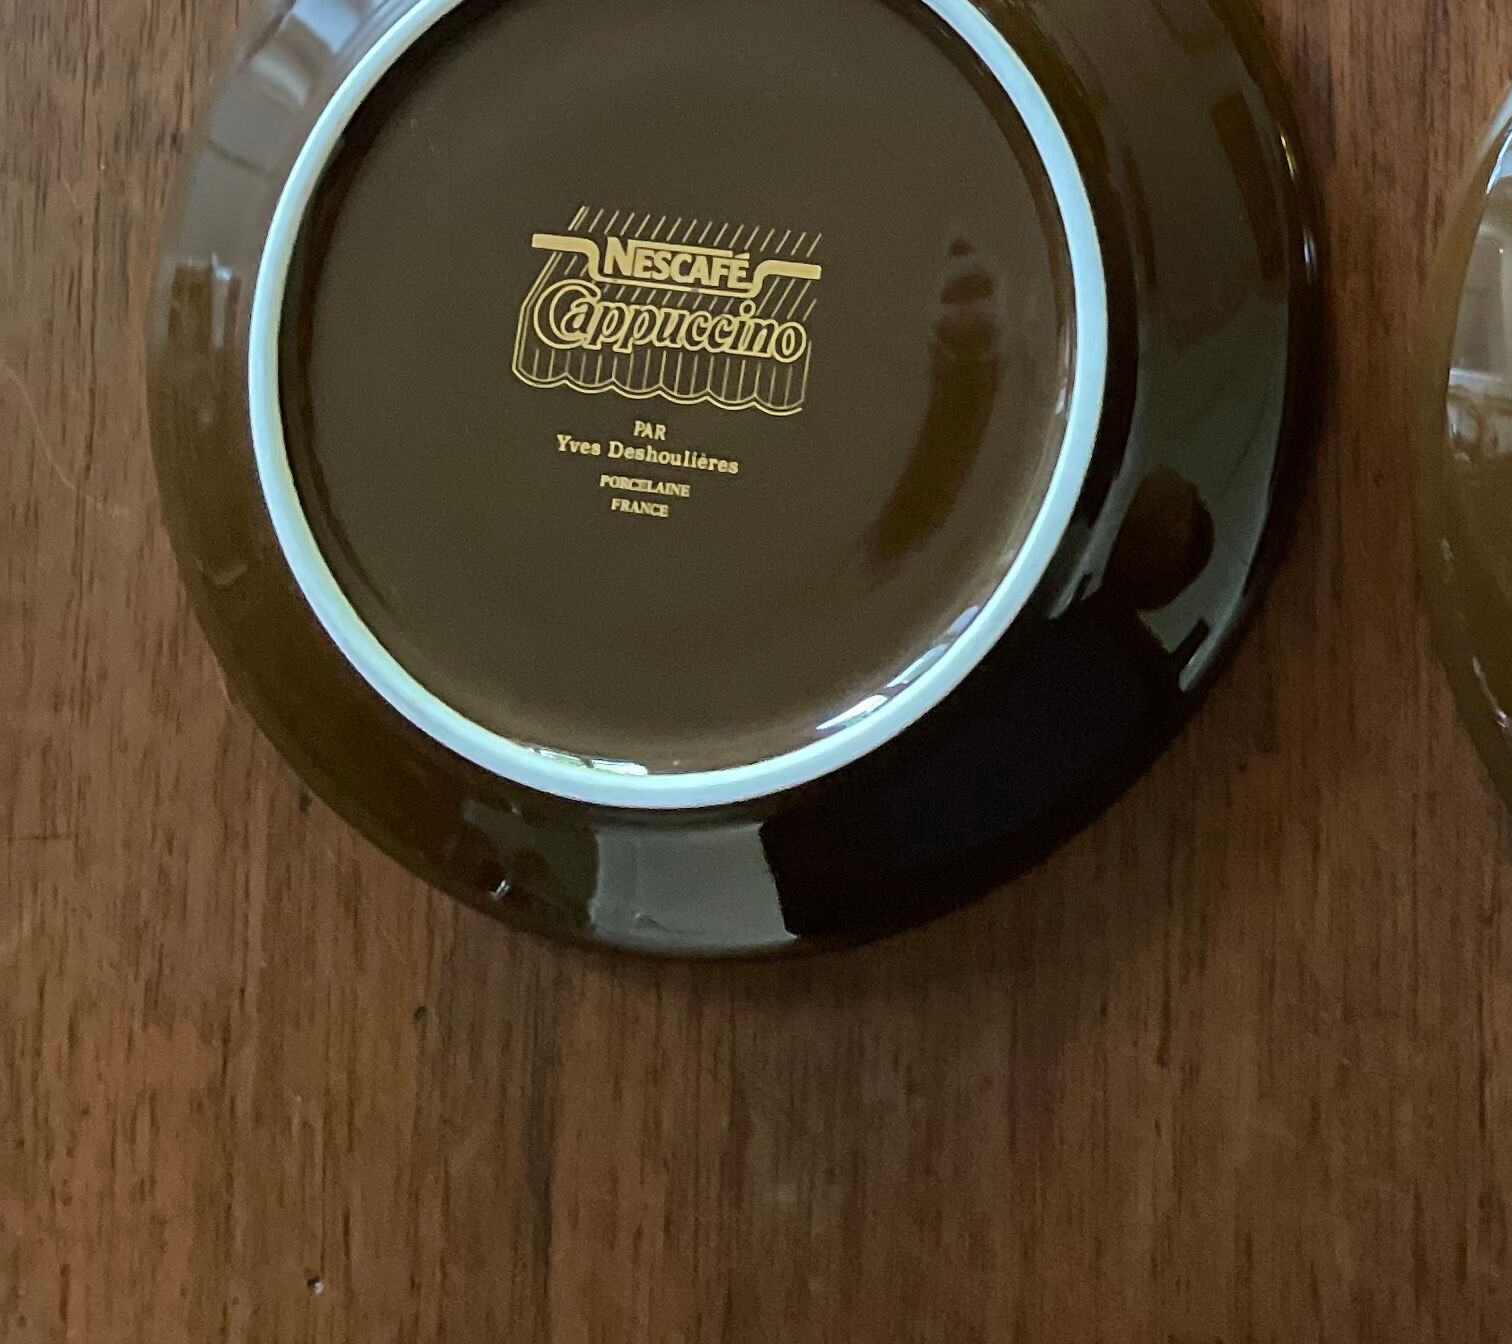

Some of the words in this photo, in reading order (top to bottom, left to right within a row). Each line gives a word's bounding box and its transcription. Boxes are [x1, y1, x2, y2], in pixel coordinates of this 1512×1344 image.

[603, 236, 750, 289] NESCAFÉ
[533, 278, 807, 363] Cappuccino
[633, 420, 666, 441] PAR
[556, 434, 601, 456] Yves
[607, 440, 739, 474] Deshoulières
[600, 474, 691, 497] PORCELAINE
[611, 498, 669, 518] FRANCE
